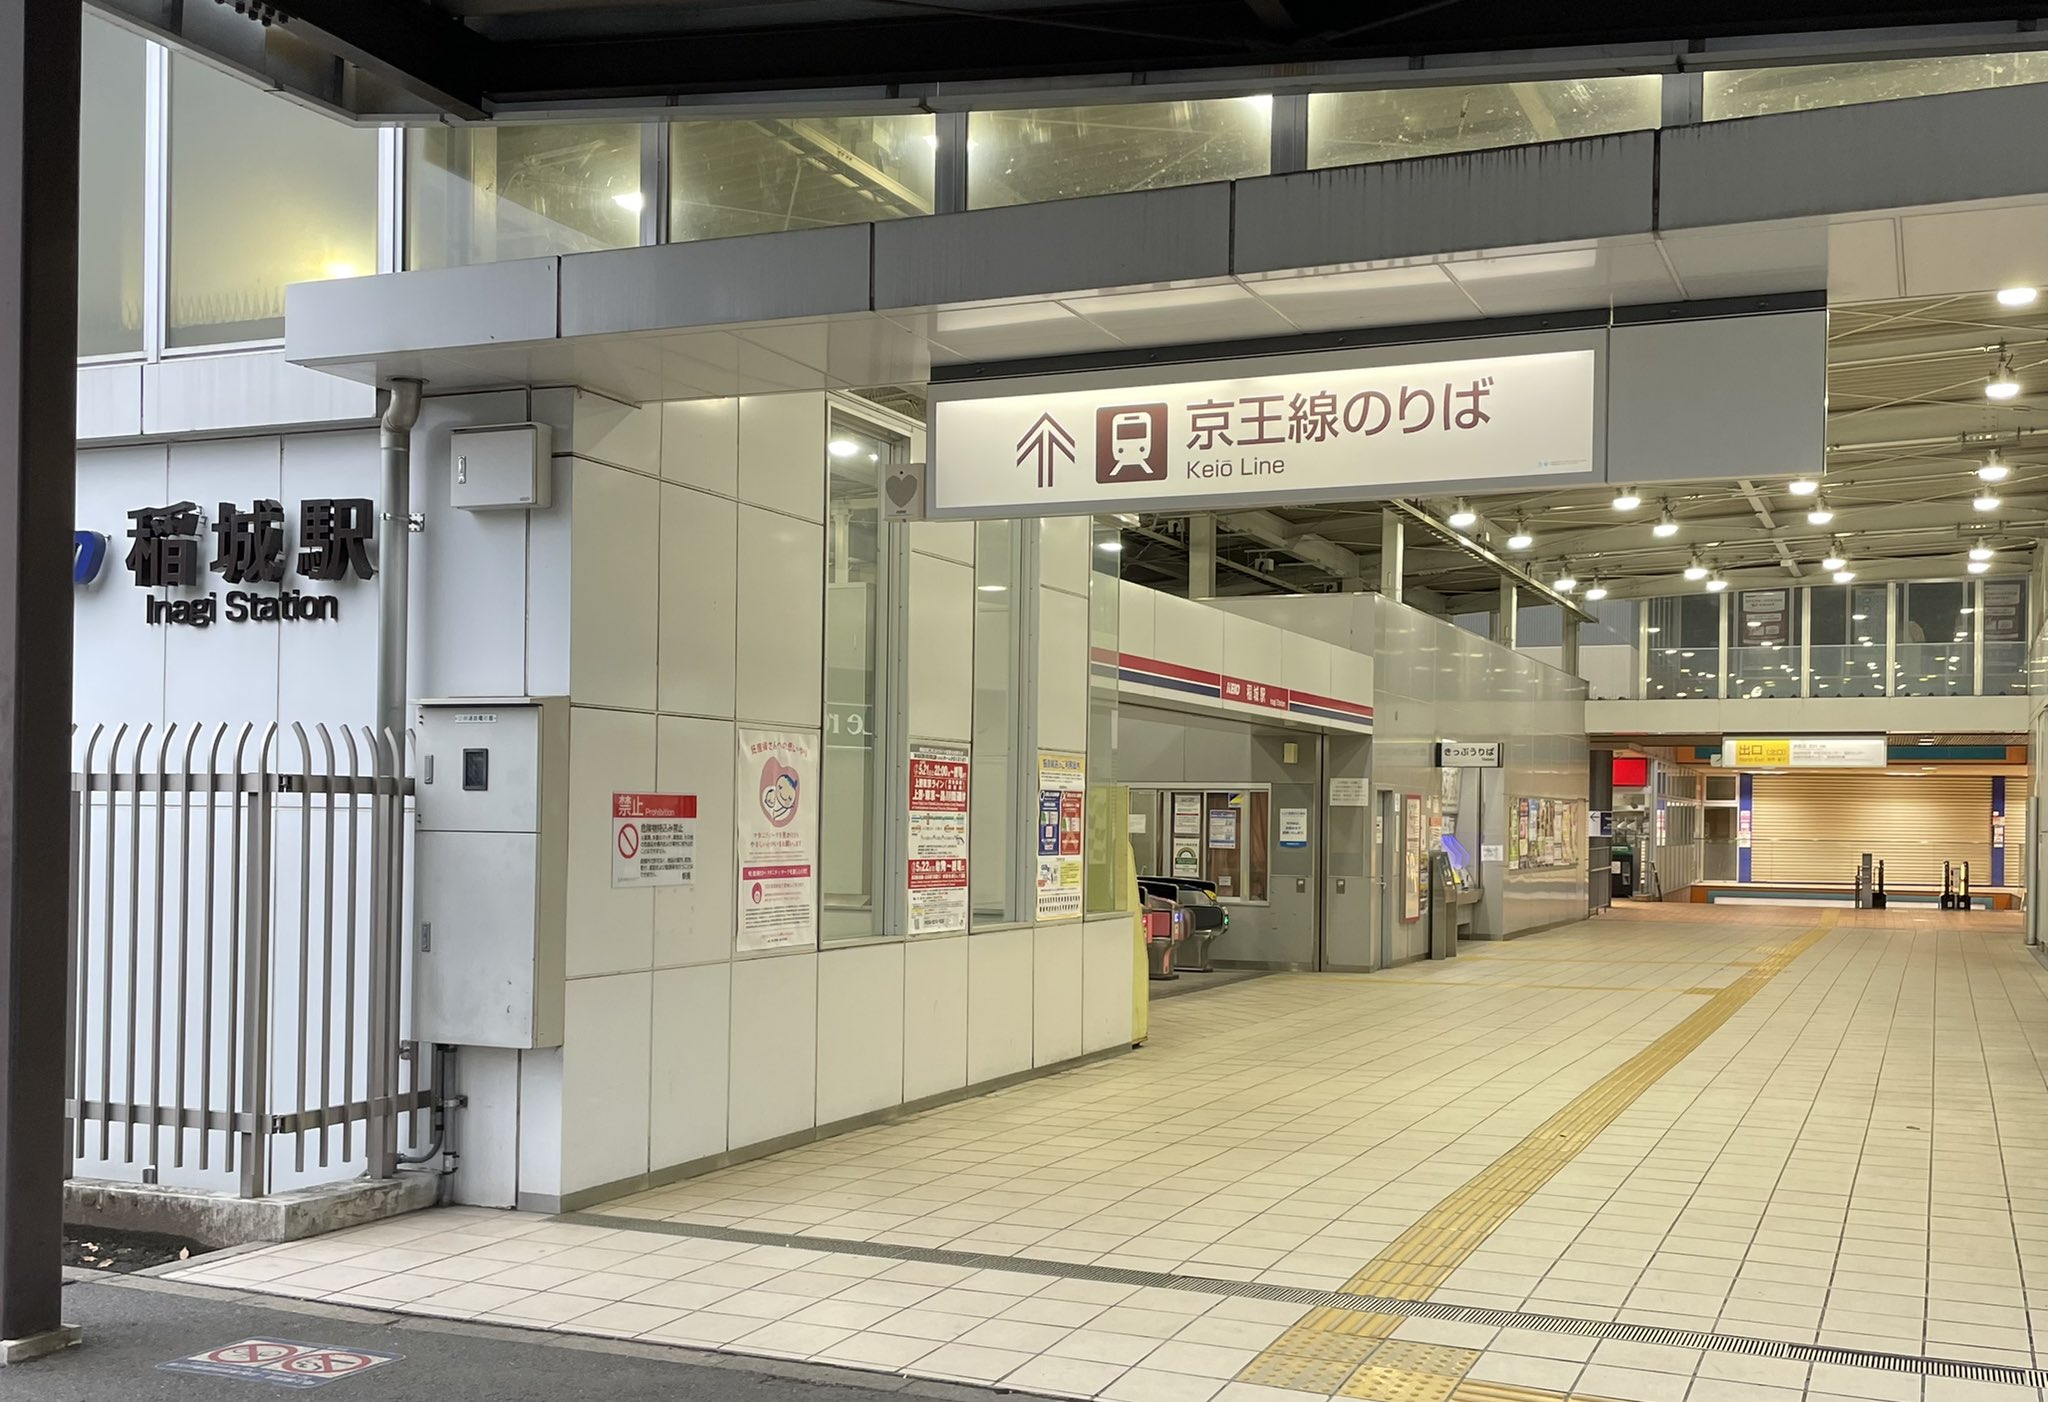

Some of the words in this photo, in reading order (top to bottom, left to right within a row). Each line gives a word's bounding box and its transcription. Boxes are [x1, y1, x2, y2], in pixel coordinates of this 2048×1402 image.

[1186, 376, 1494, 452] 京王線のりば
[1186, 457, 1233, 480] Keiō
[1240, 456, 1285, 475] Line
[124, 498, 374, 587] 稲城駅
[146, 591, 217, 628] Inagi
[224, 589, 339, 623] Station
[1444, 747, 1495, 756] きっぷうりば
[1739, 744, 1763, 756] 出口
[618, 795, 644, 816] 禁止
[645, 808, 675, 817] Prohibition
